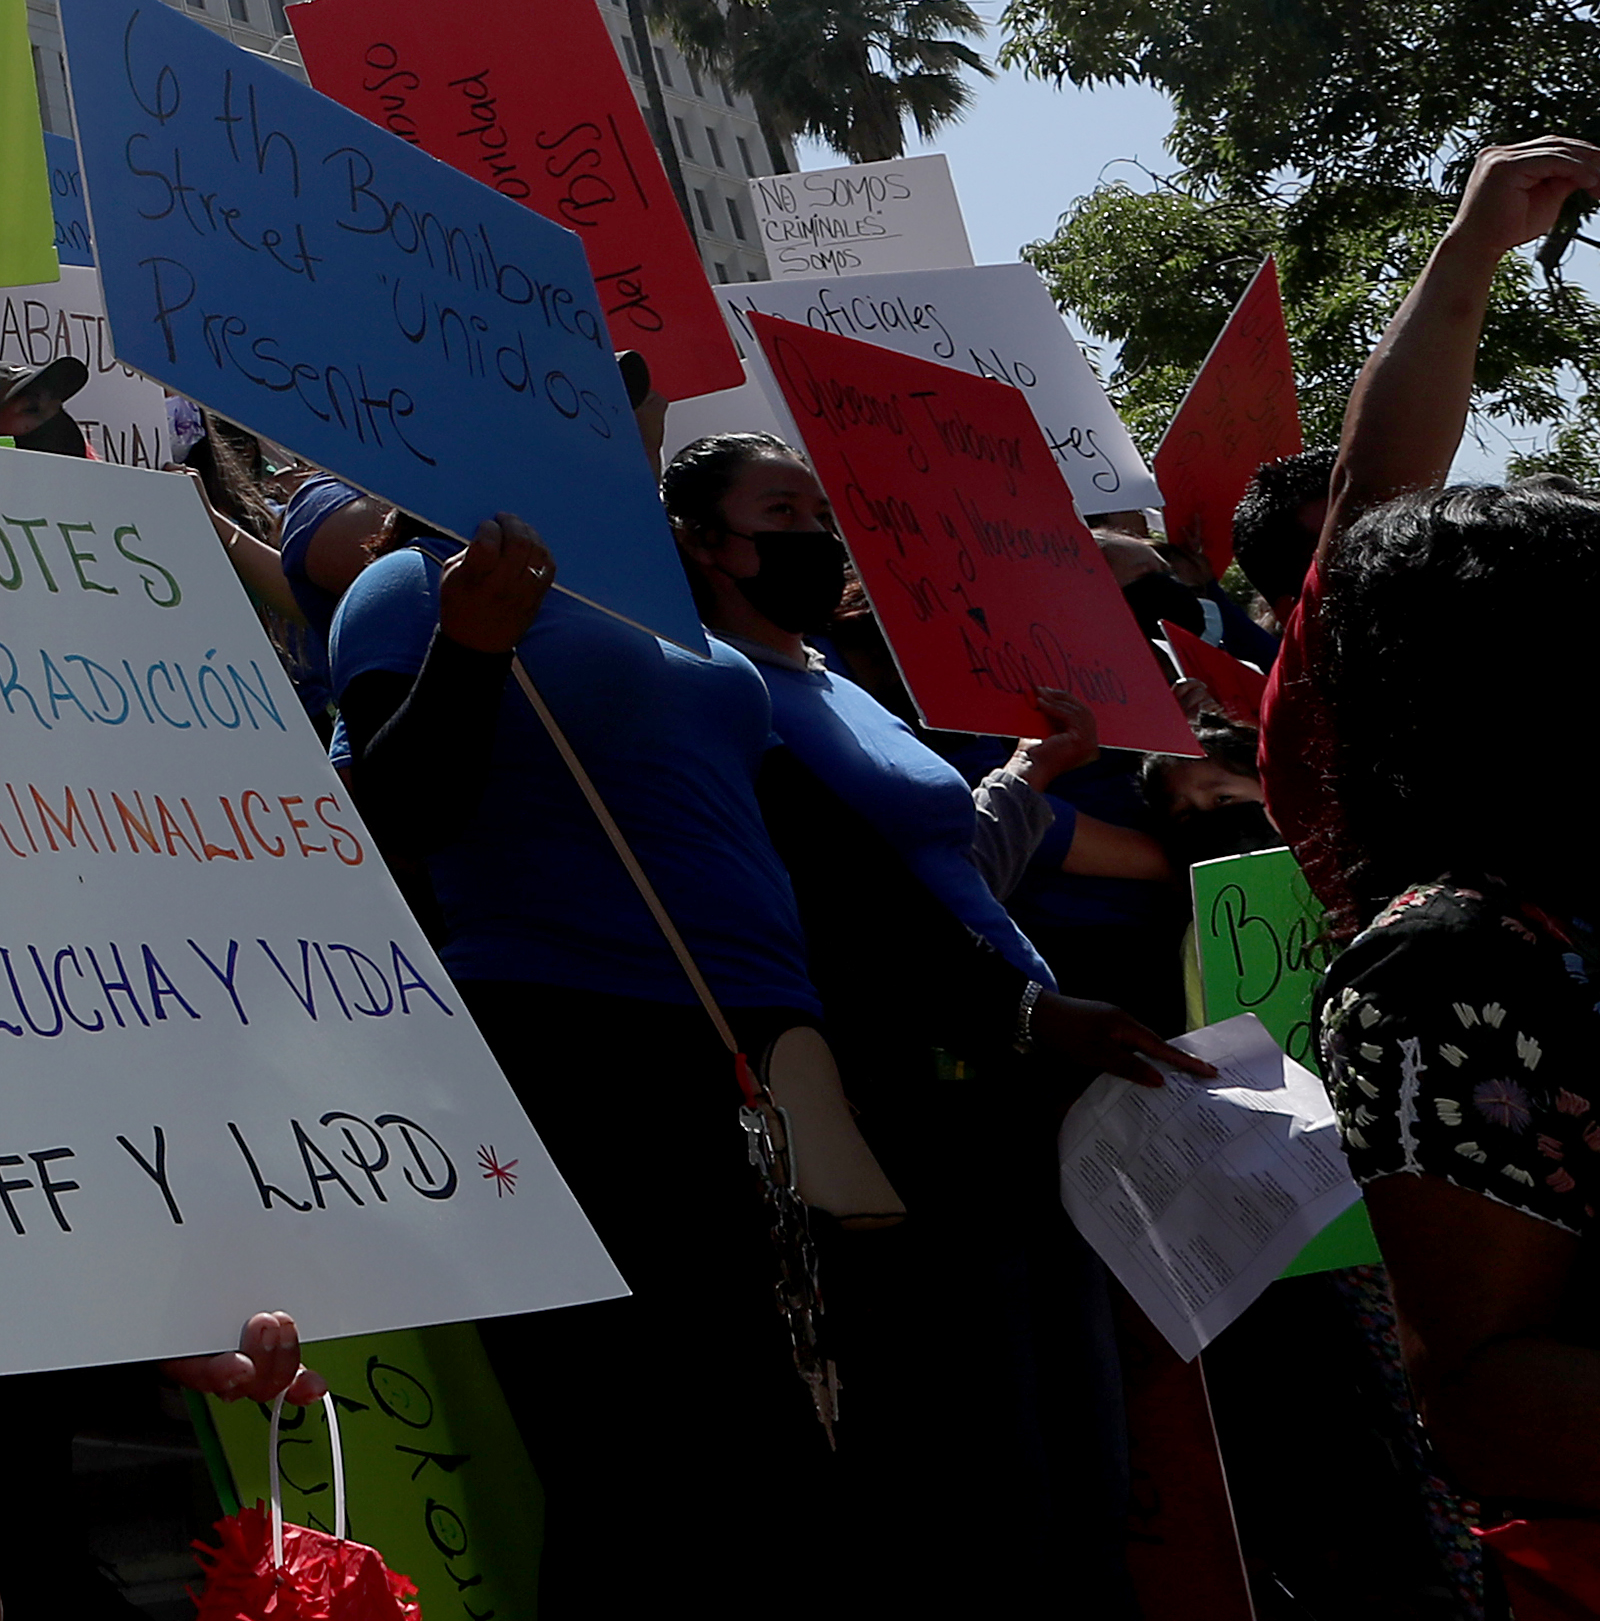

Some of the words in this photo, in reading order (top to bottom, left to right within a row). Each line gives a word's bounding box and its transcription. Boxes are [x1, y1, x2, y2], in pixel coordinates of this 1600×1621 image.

[126, 133, 323, 281] Street
[804, 174, 911, 212] SOMOS
[138, 258, 437, 467] Presente
[807, 289, 955, 359] oficiales
[187, 937, 251, 1026] Y
[256, 937, 454, 1020] VIDA
[115, 1125, 186, 1226] Y
[227, 1111, 460, 1214] LAPD
